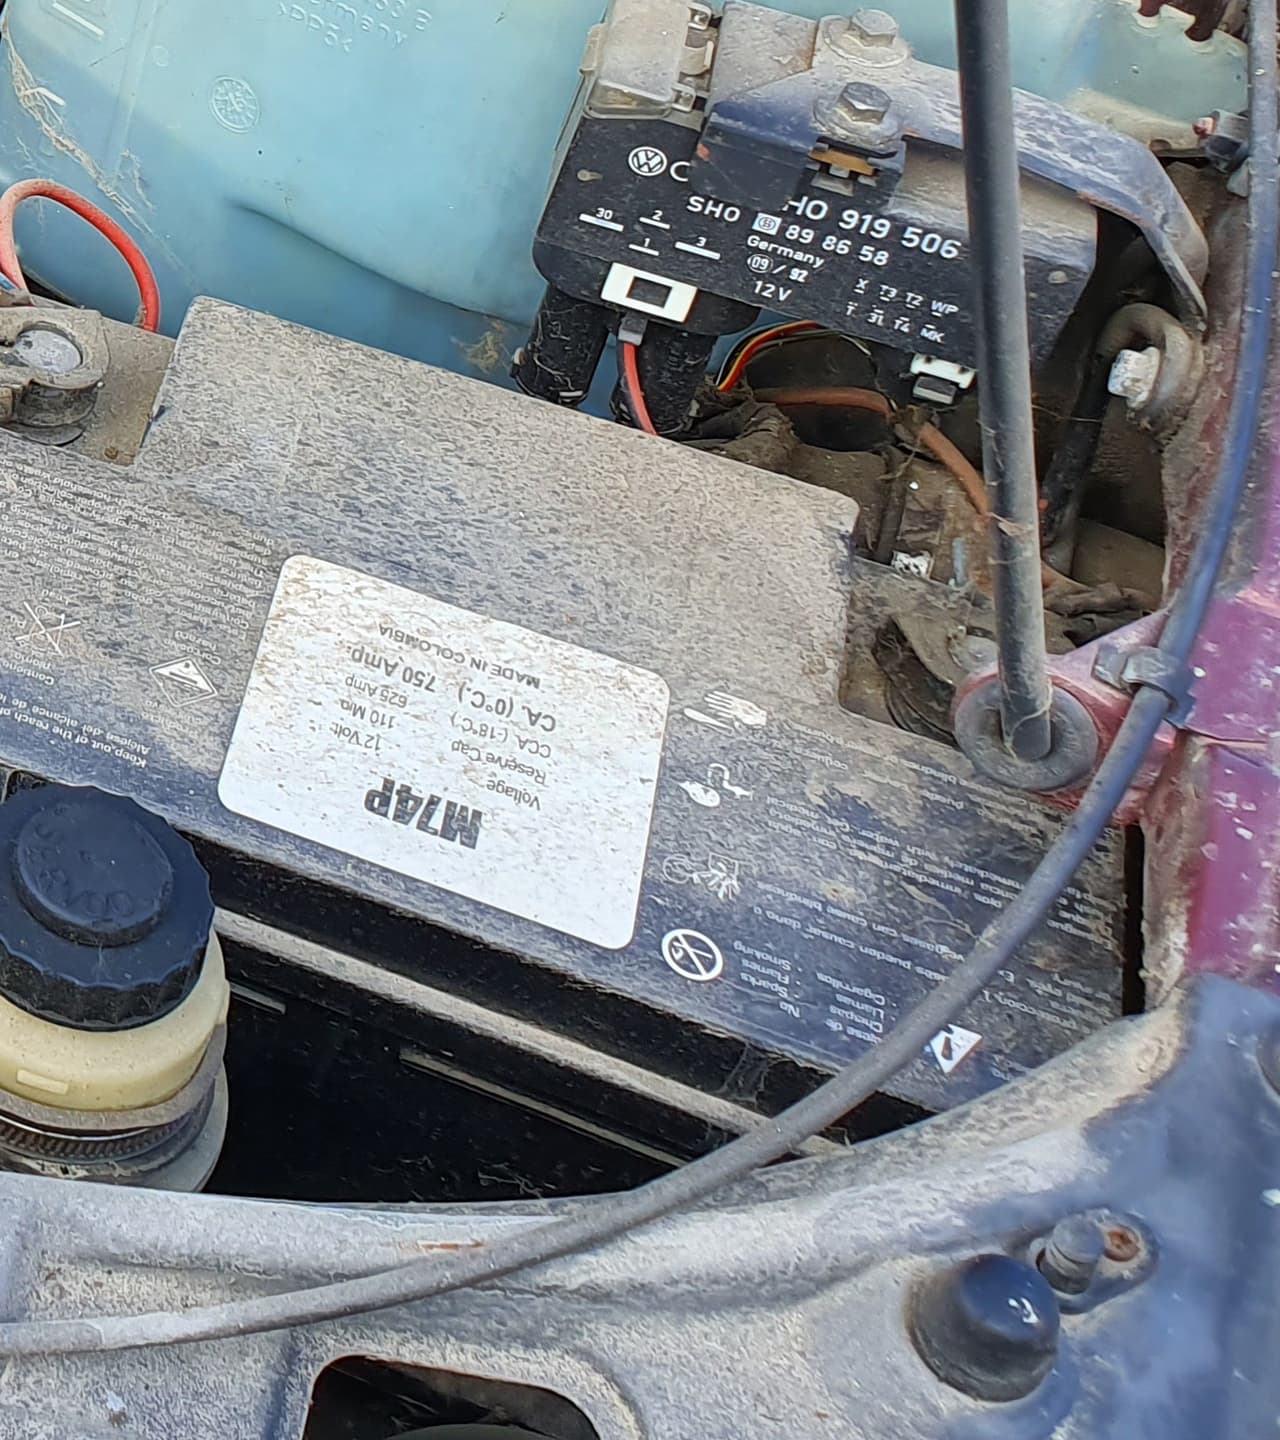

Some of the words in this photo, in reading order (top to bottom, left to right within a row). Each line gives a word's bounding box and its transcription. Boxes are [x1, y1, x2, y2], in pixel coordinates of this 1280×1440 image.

[596, 207, 613, 221] 30
[652, 210, 663, 221] 2
[644, 237, 651, 248] 1
[696, 236, 707, 247] 3
[838, 208, 892, 239] 919
[900, 225, 963, 260] 506
[746, 235, 825, 269] Germany
[785, 224, 815, 244] 89
[822, 235, 852, 255] 86
[858, 245, 889, 266] 58
[855, 278, 870, 290] X
[931, 300, 959, 314] WP
[379, 624, 465, 664] COLOMBIA
[470, 657, 488, 672] IN
[402, 667, 436, 693] 750
[490, 664, 540, 689] MADE
[11, 698, 28, 711] de
[380, 689, 408, 708] 625
[14, 712, 50, 732] reach
[370, 710, 396, 729] 110
[52, 726, 73, 741] the
[76, 733, 89, 746] of
[364, 734, 382, 751] 12
[91, 740, 111, 754] out
[114, 748, 147, 769] Keep
[486, 753, 546, 786] Reserve
[486, 780, 541, 811] Voltage
[364, 777, 483, 851] M74P
[733, 940, 792, 972] Smoking
[741, 958, 790, 985] Flames
[740, 972, 789, 999] Sparks
[780, 1001, 800, 1018] No
